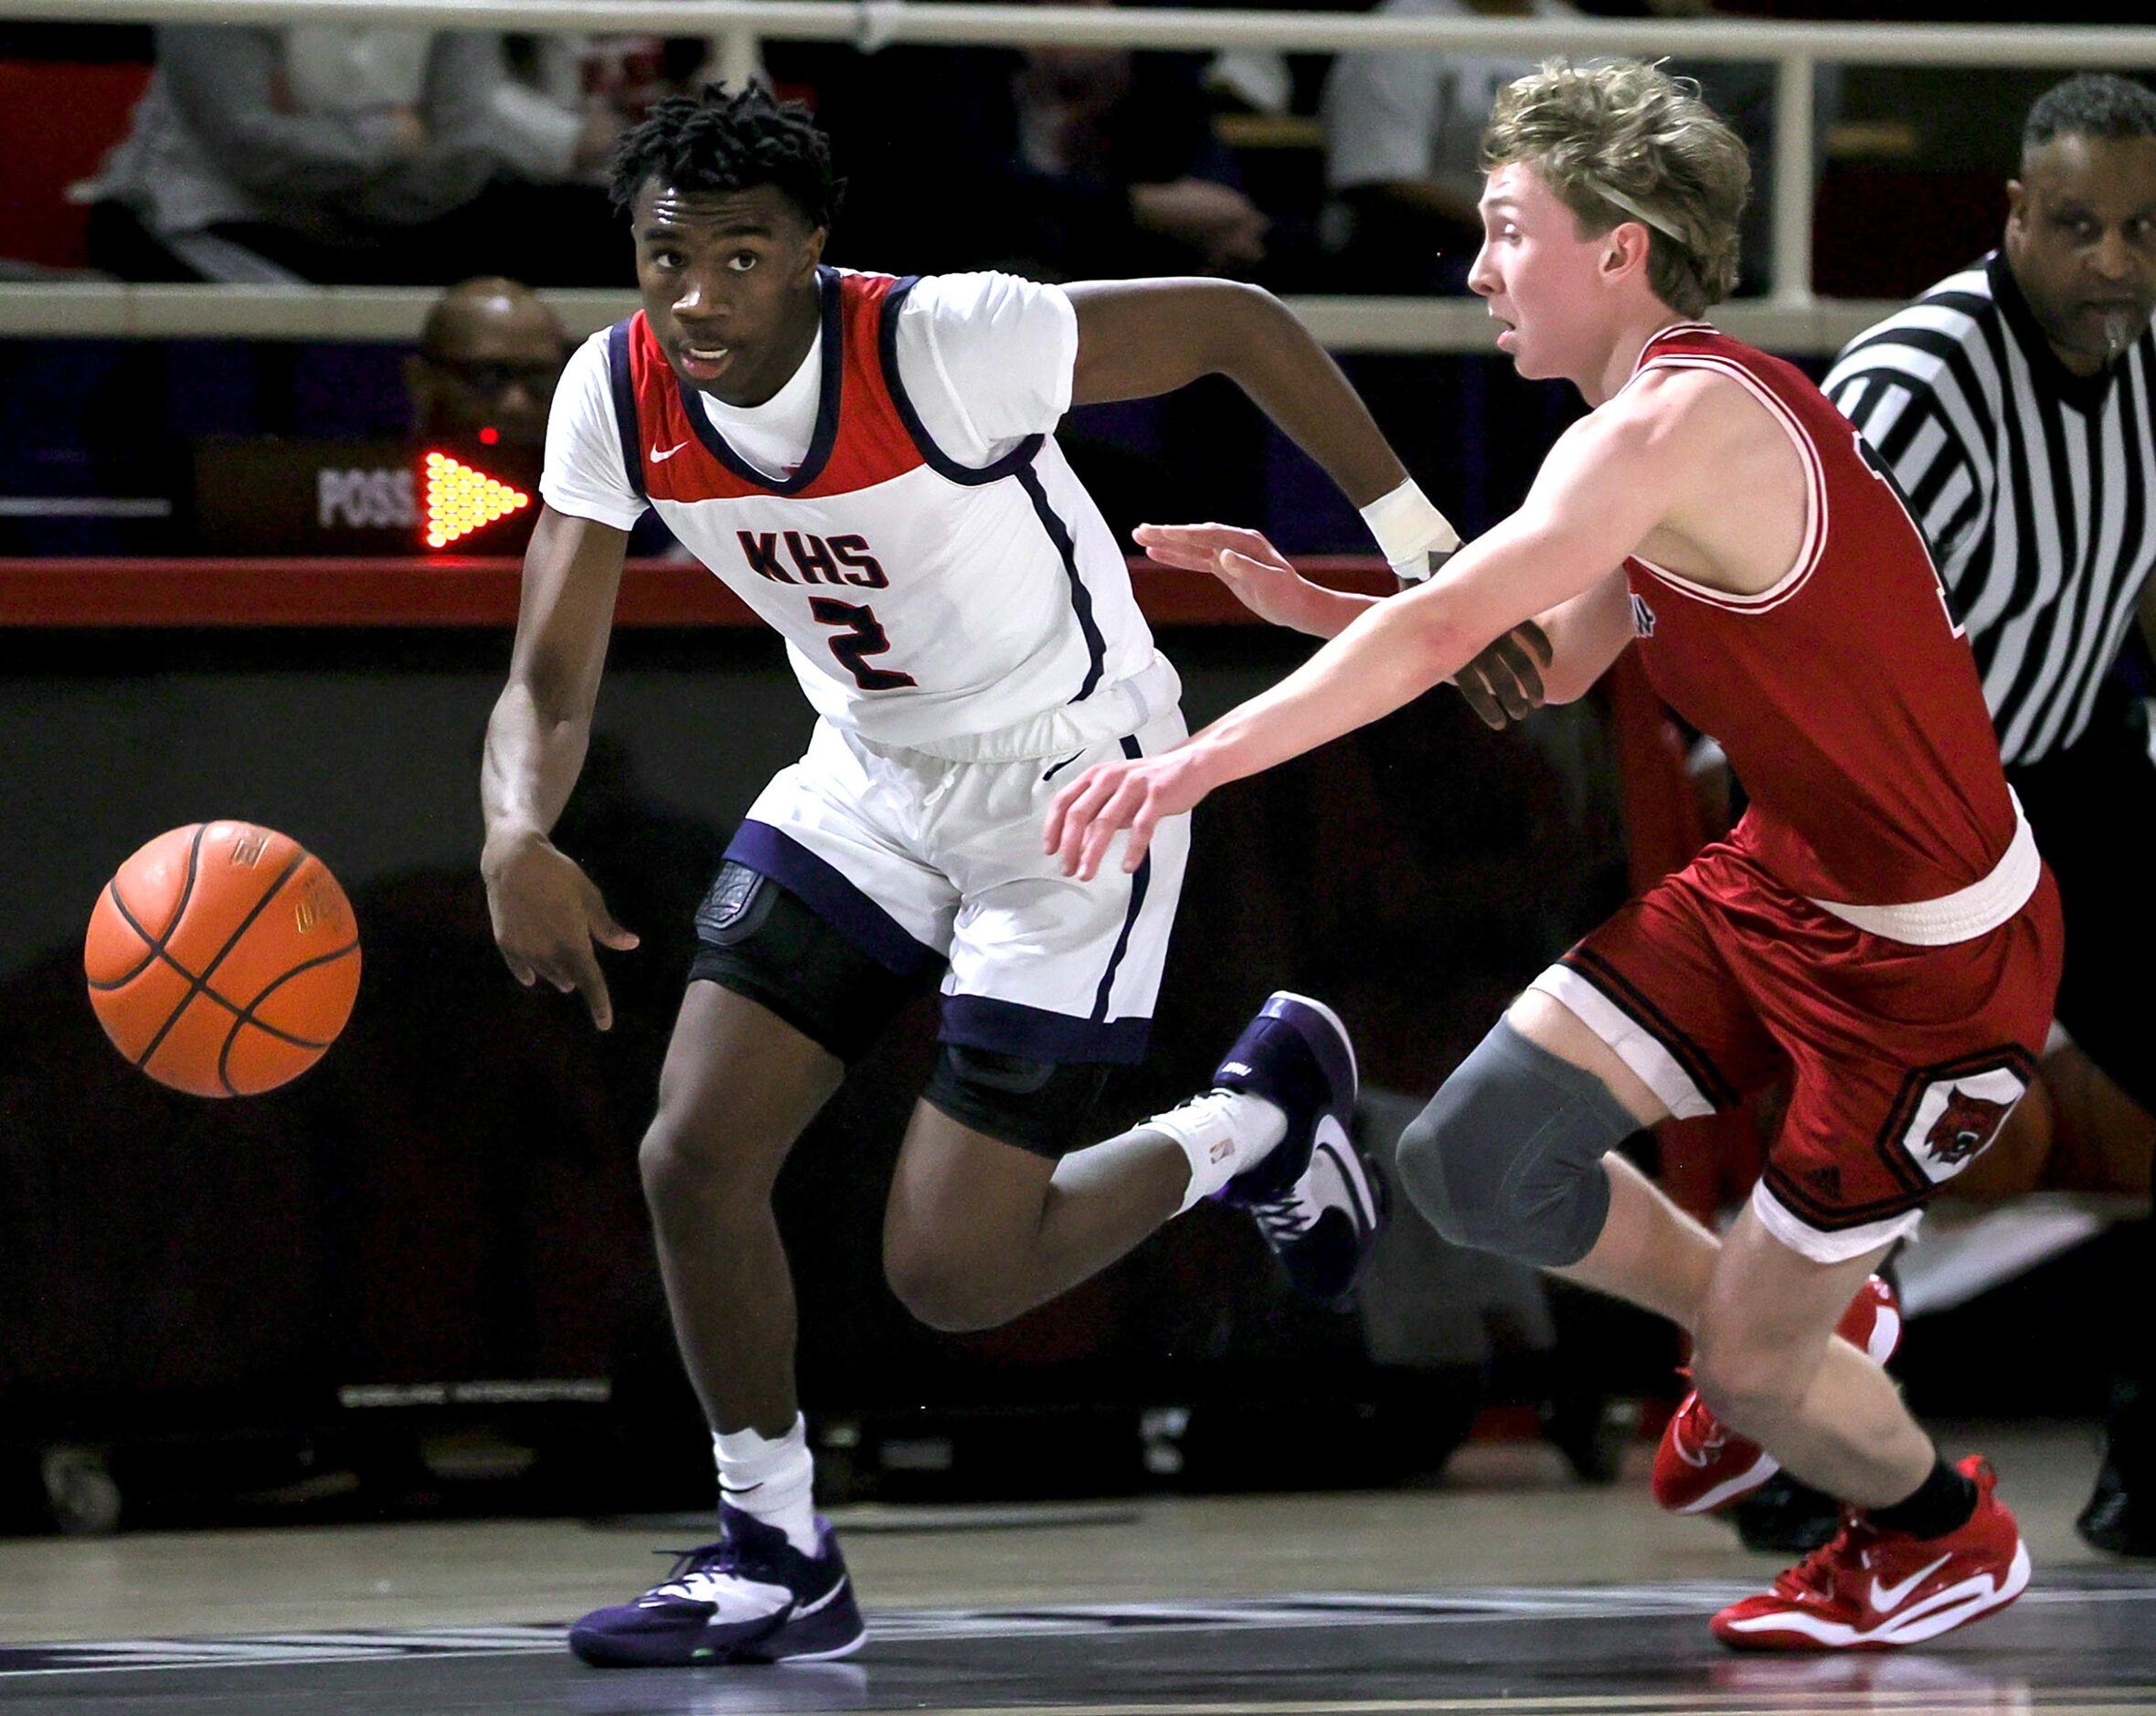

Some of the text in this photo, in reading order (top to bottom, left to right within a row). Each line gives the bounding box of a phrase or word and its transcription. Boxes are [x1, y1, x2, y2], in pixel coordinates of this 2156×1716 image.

[317, 468, 415, 528] POSS
[736, 530, 890, 589] KHS
[807, 596, 919, 691] 2
